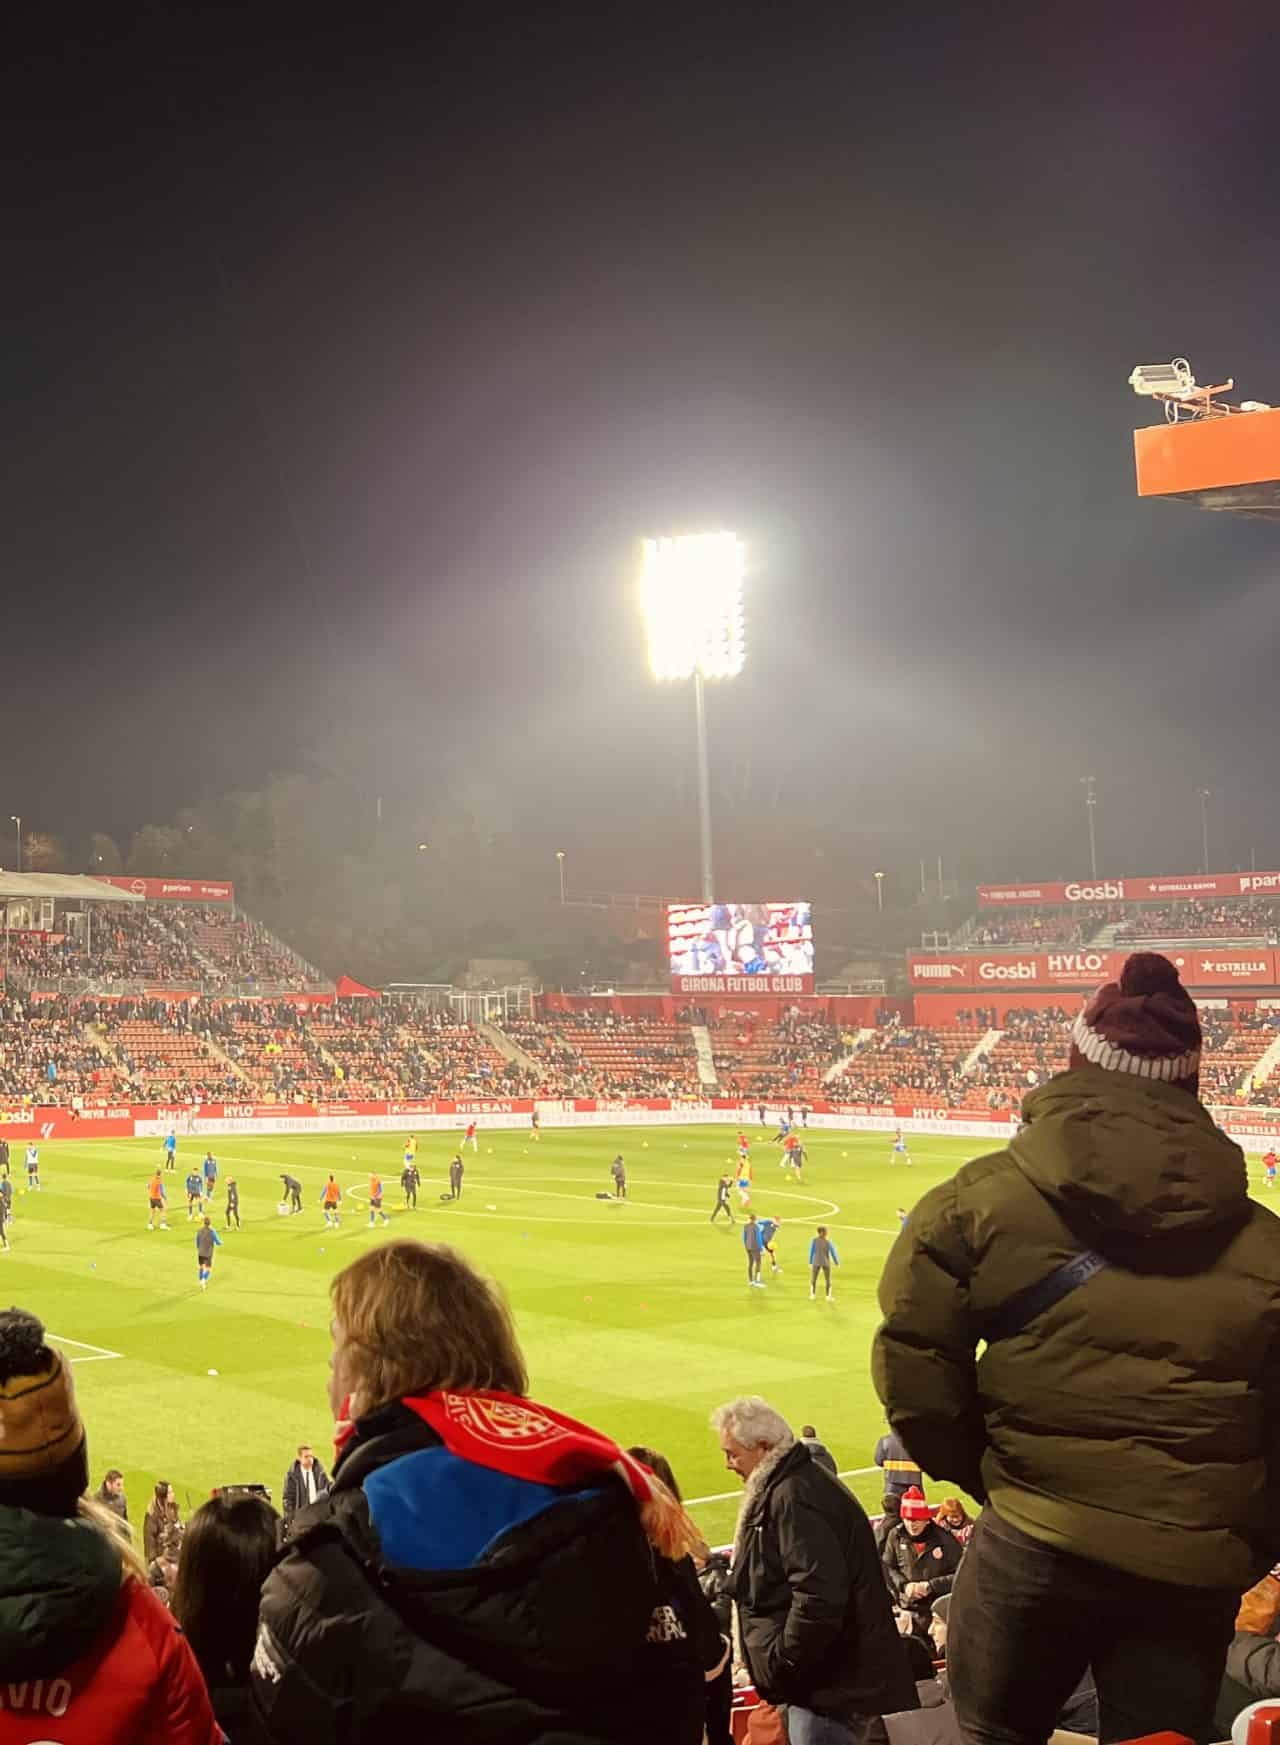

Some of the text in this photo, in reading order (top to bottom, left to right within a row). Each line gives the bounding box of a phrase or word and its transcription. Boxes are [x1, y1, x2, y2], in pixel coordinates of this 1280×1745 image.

[1252, 873, 1280, 891] par
[1065, 881, 1124, 900] Gosbi
[979, 961, 1037, 979] Gosbi
[1048, 955, 1102, 971] HYLO
[1215, 962, 1266, 972] ESTRELLA
[681, 977, 803, 992] GIRONA FUTBOL CLUB
[223, 1105, 254, 1117] HYLO
[456, 1103, 512, 1112] NISSAN
[913, 1108, 947, 1120] HYLO
